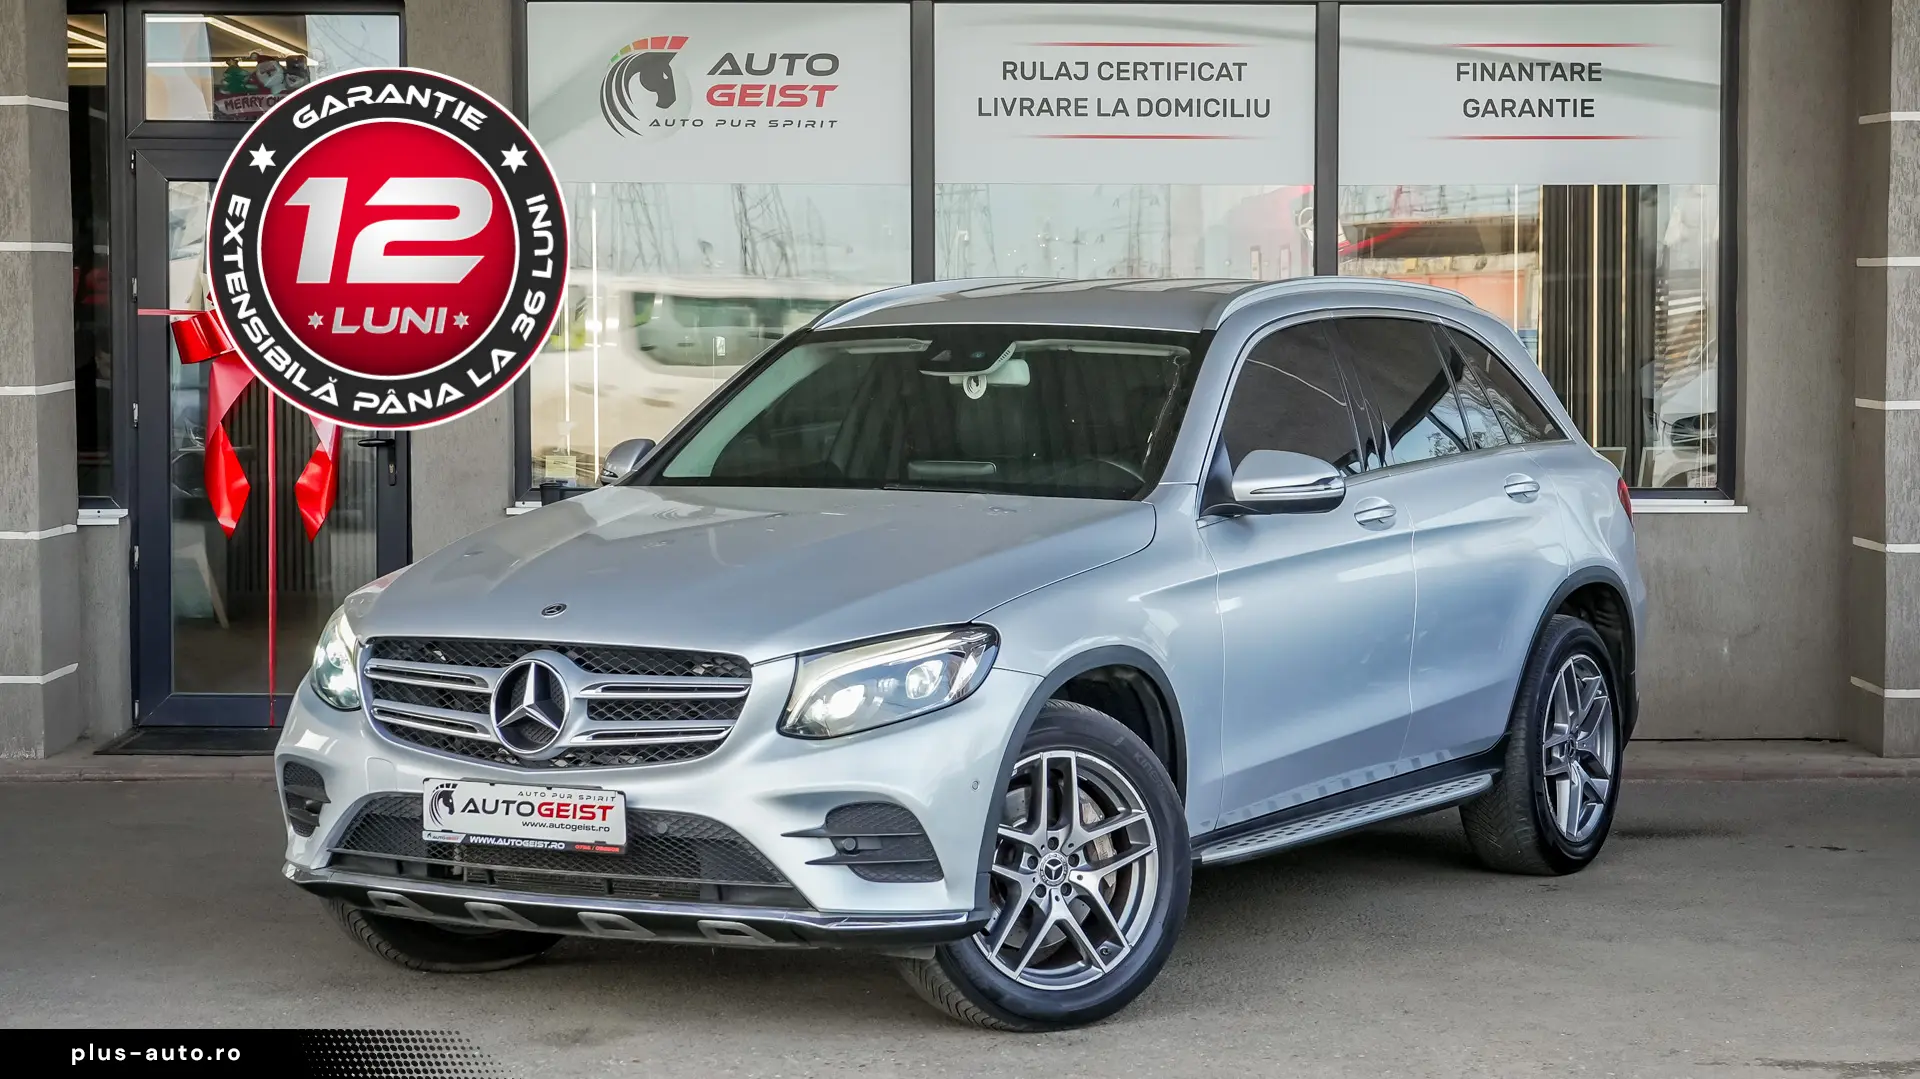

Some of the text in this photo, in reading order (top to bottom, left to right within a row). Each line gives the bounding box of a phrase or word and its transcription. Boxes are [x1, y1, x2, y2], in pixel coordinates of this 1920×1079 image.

[706, 52, 840, 77] AUTO
[1002, 61, 1247, 82] RULAJ CERTIFICAT
[1456, 62, 1602, 82] FINANTARE
[224, 95, 264, 110] MERRY
[706, 84, 839, 107] GEIST
[977, 97, 1271, 118] LIVRARE LA DOMICILIU
[1462, 98, 1595, 118] GARANTIE
[649, 118, 838, 128] AUTO PUR SPIRIT
[552, 792, 573, 800] PUR
[578, 794, 616, 802] SPIRIT
[461, 797, 615, 821] AUTOGEIST
[521, 820, 611, 832] www.autogeist.ro
[469, 835, 565, 850] WWW.AUTOGEIST.RO
